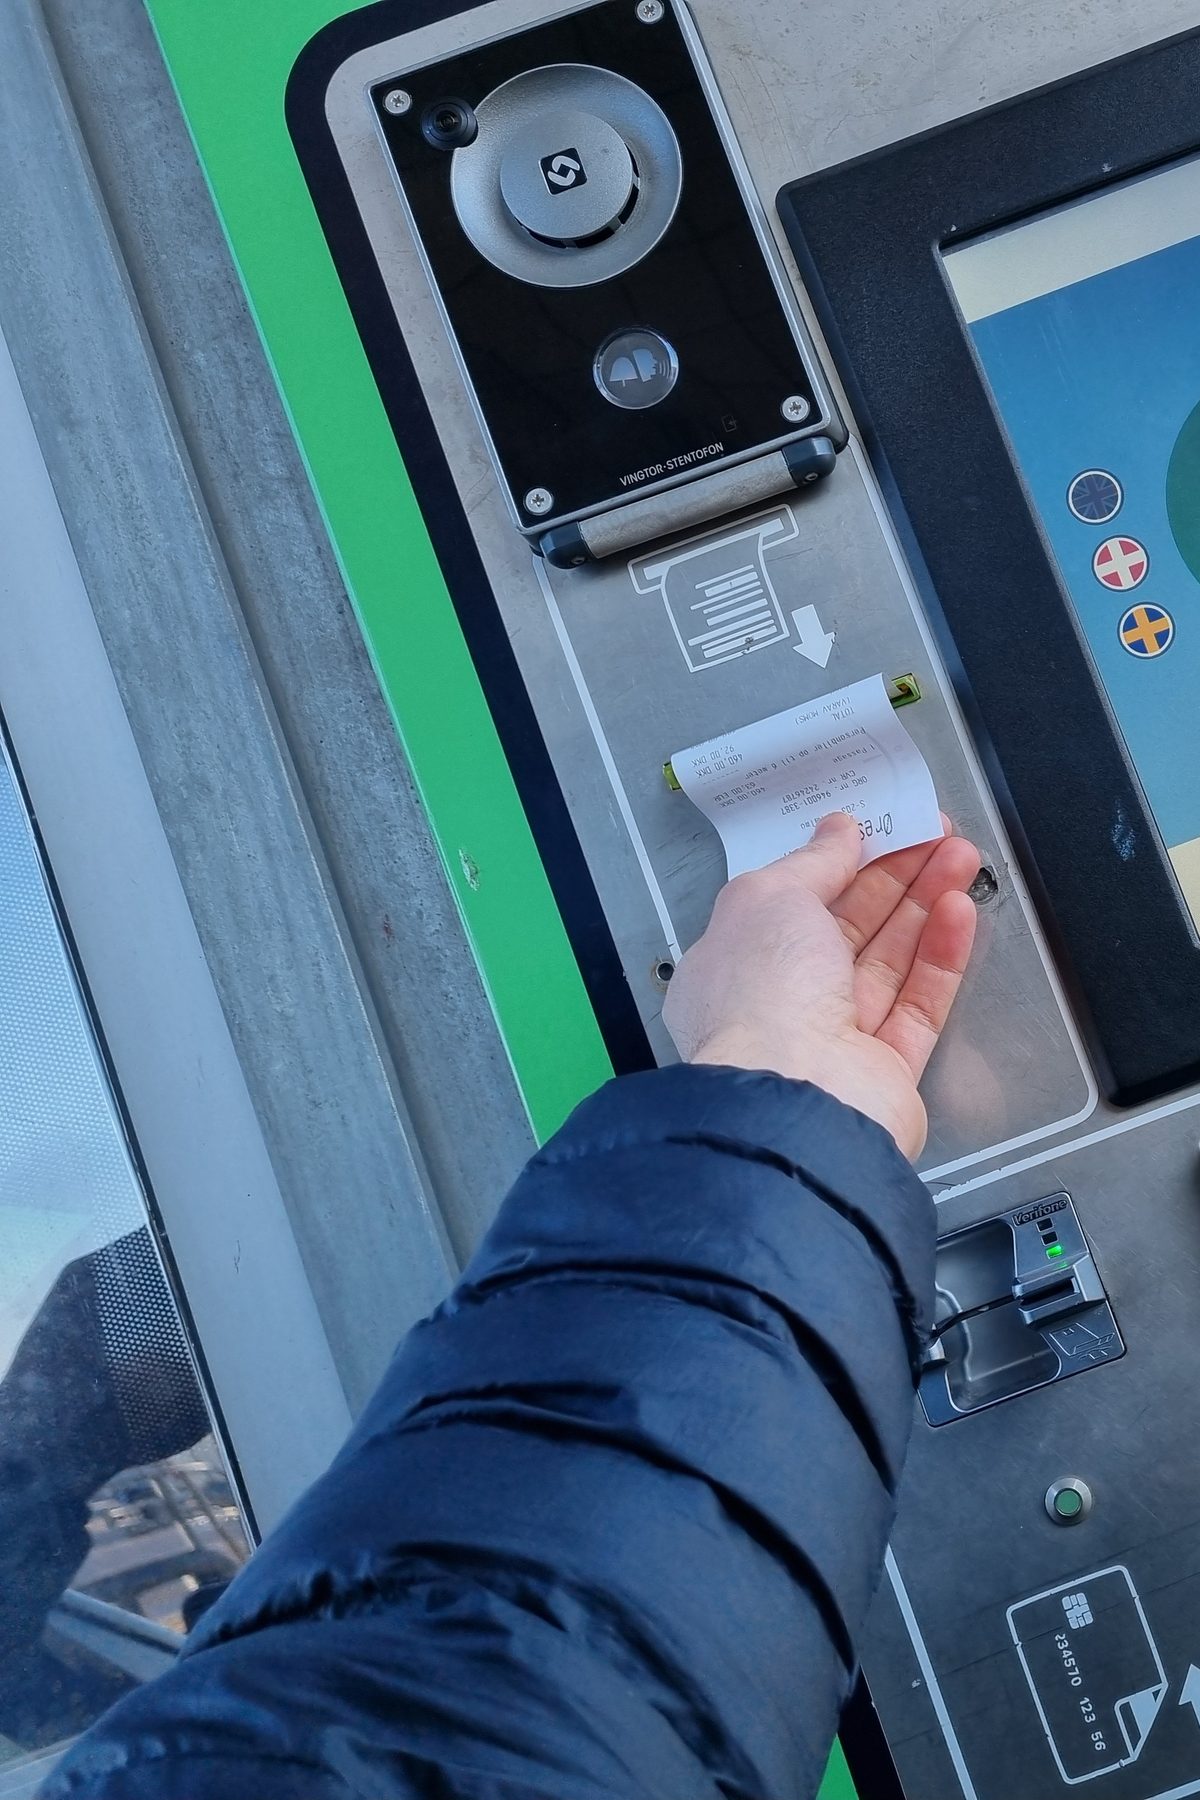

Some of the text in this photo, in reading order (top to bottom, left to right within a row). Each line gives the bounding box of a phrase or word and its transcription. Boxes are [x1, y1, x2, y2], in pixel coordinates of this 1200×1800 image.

[832, 707, 855, 720] TOTAL
[691, 755, 707, 768] DKK
[695, 766, 712, 778] DKK
[853, 775, 868, 787] ORG
[1012, 1199, 1068, 1226] Verifone
[1054, 1633, 1106, 1751] 234570 123 56
